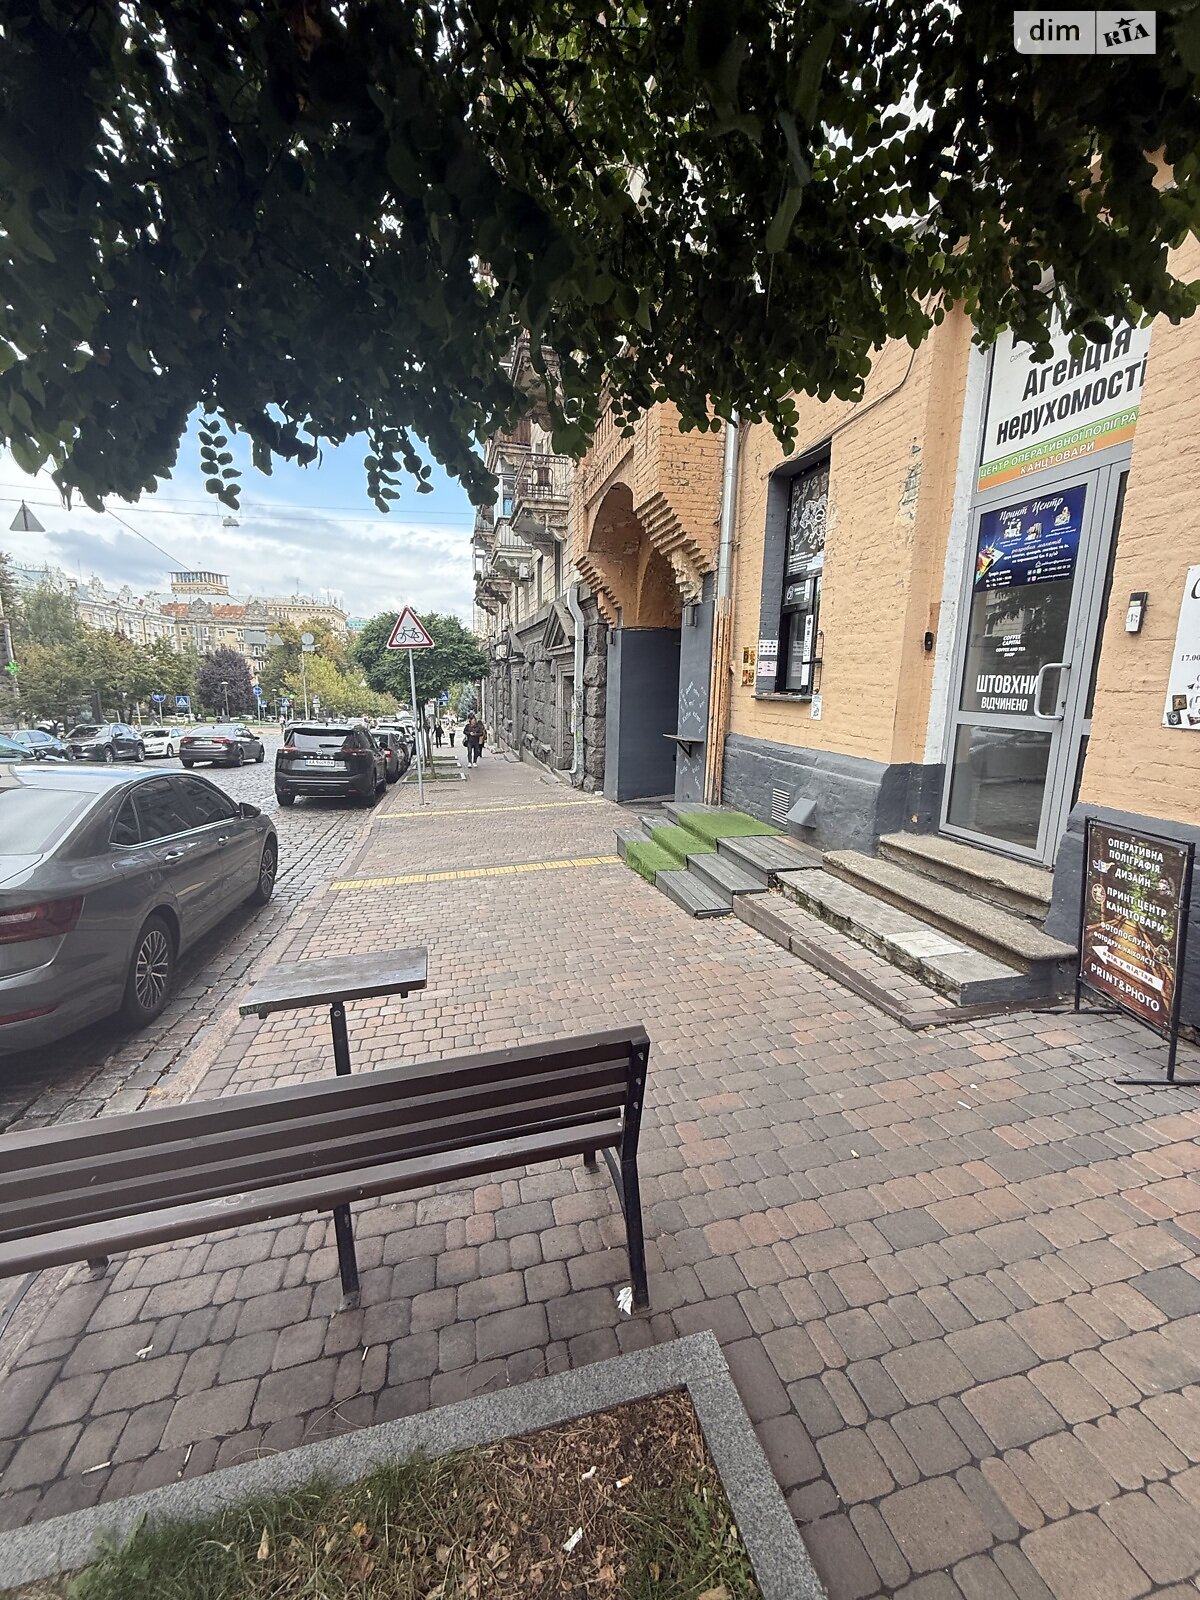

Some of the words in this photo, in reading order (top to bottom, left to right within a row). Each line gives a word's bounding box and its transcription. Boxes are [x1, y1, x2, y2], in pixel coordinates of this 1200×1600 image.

[1022, 327, 1132, 401] Агенція
[996, 352, 1148, 446] нерухомості
[980, 460, 1009, 479] ЦЕНТР
[1011, 430, 1084, 466] ОПЕРАТИВНОЇ
[1085, 411, 1138, 439] ПОЛІГРА
[1020, 440, 1096, 475] КАНЦТОВАРИ
[999, 506, 1028, 525] Принт
[1031, 497, 1064, 516] Центр
[975, 674, 1039, 695] ШТОВХНИ
[980, 696, 1029, 712] ВІДЧИНЕНО
[1107, 837, 1164, 863] ОПЕРАТИВНА
[1109, 849, 1161, 874] ПОЛІГРАФІЯ
[1114, 868, 1151, 888] ДИЗАЙН
[1106, 886, 1135, 904] ПРИНТ
[1137, 899, 1167, 918] ЦЕНТР
[1106, 900, 1166, 934] КАНЦТОВАРИ
[1093, 931, 1122, 950] ФОТОДРУК
[1132, 952, 1155, 967] ХОЛСТІ
[1100, 921, 1151, 952] ФОТОПОСЛУГИ
[1090, 962, 1160, 1012] PRINT&PHOTO
